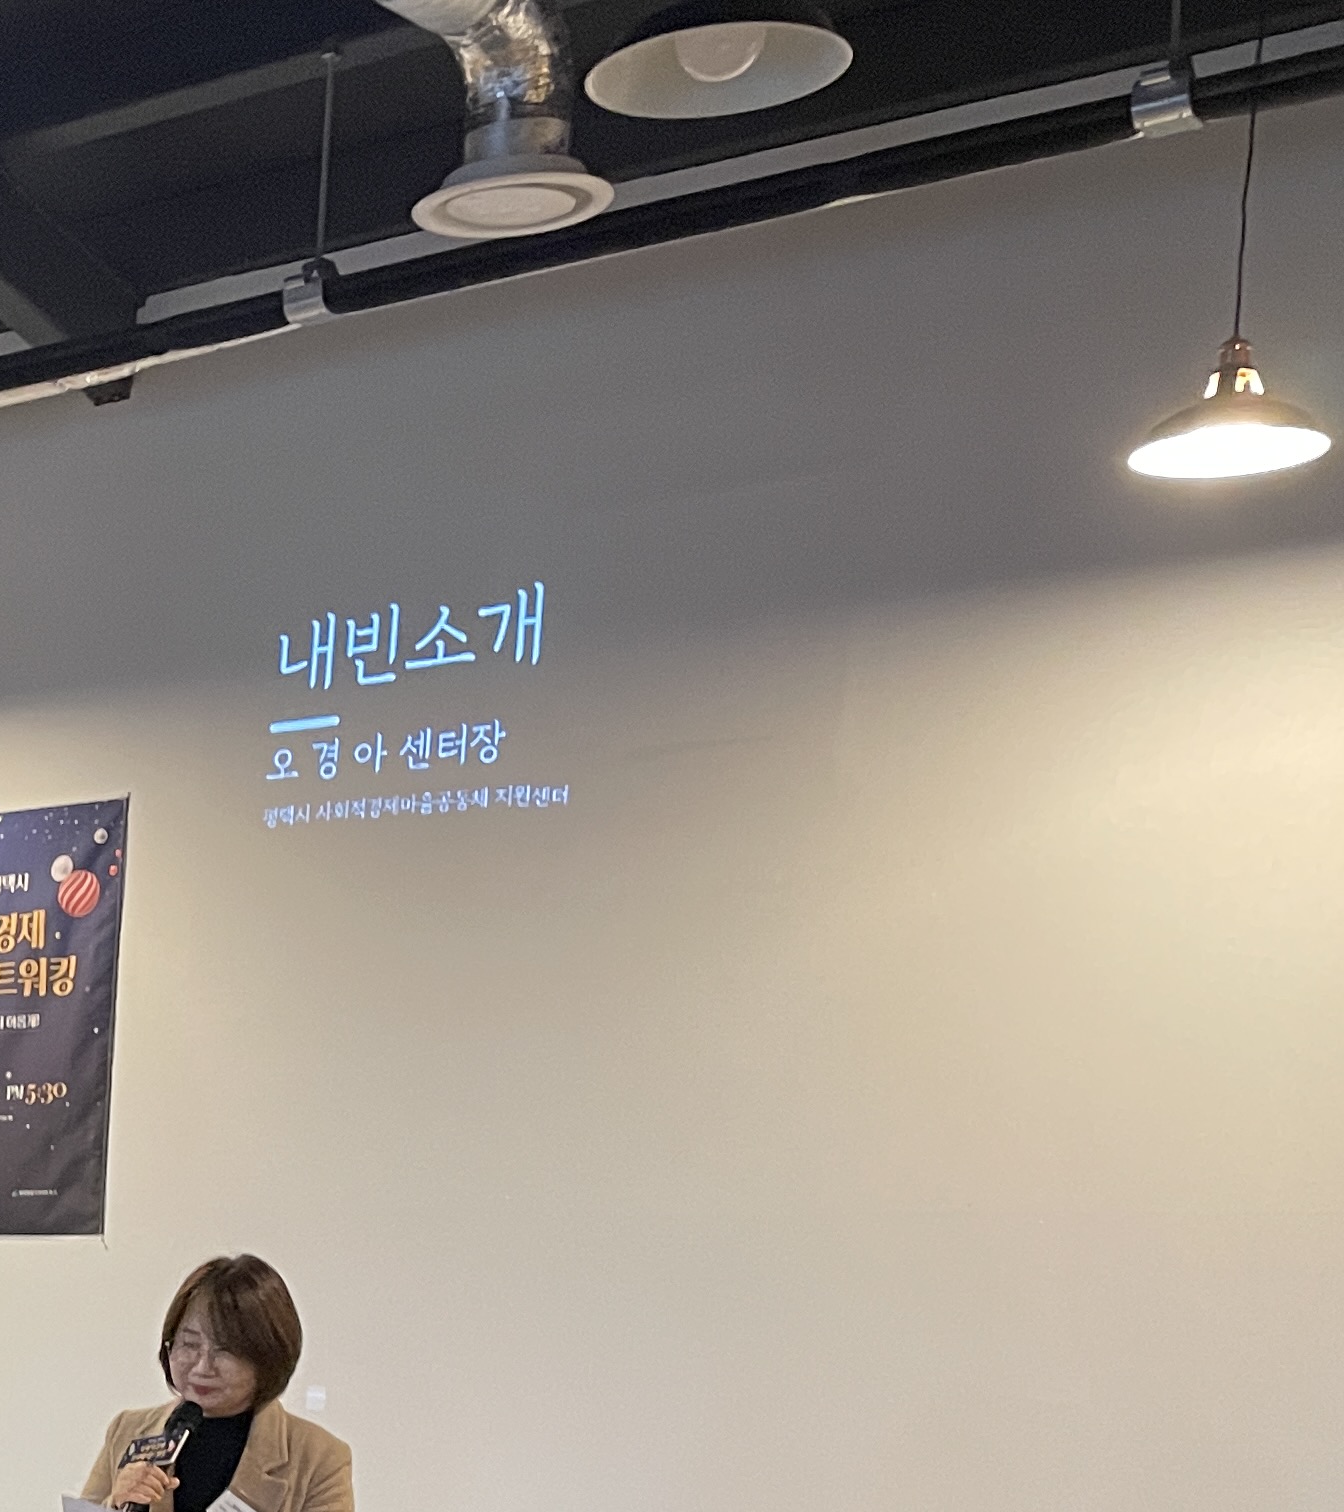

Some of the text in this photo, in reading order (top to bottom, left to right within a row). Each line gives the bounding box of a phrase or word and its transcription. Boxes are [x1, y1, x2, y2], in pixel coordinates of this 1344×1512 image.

[279, 581, 545, 690] 내빈소개
[266, 718, 507, 780] 오 경 아 센터장
[24, 1081, 67, 1105] 5:30
